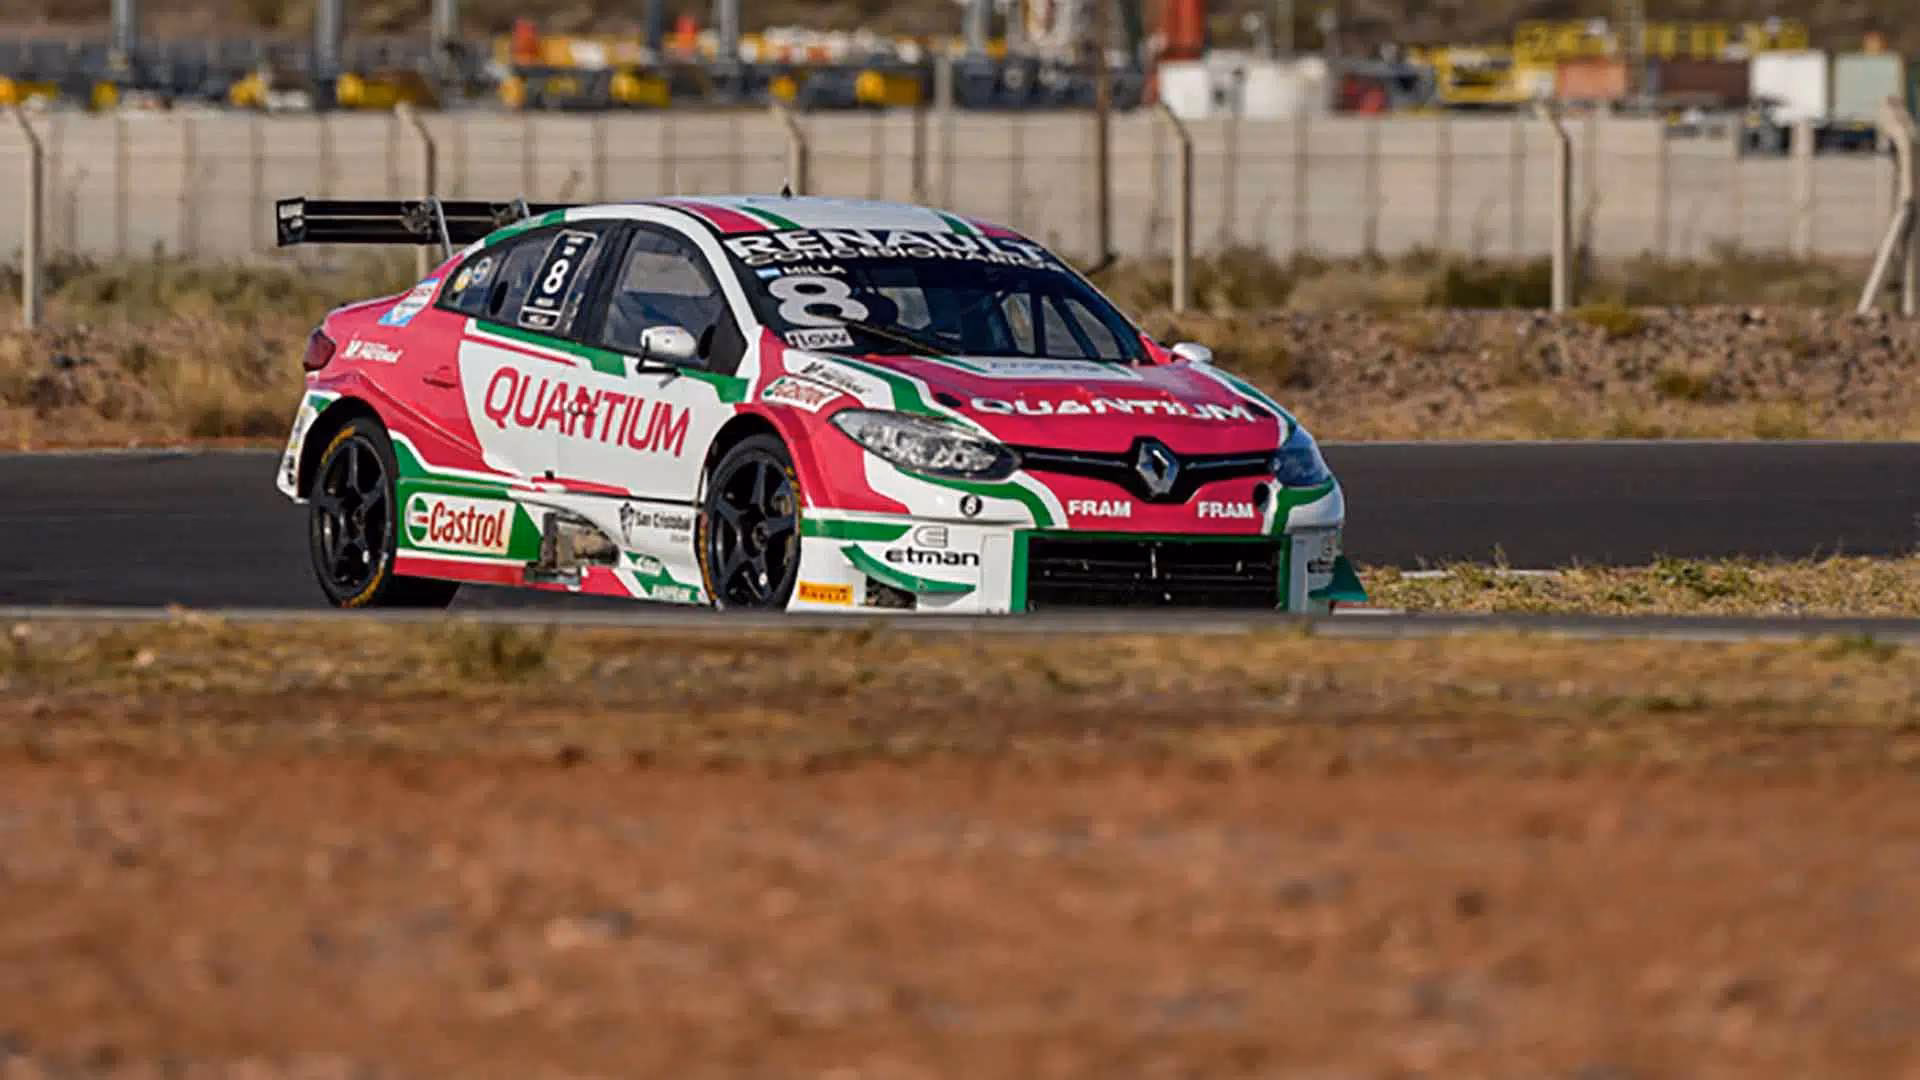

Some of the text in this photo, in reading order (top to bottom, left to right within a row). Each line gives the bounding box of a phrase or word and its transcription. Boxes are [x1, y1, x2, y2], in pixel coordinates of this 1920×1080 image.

[722, 230, 1044, 260] RENAULT
[543, 258, 570, 294] 8
[782, 264, 848, 275] MILLA
[767, 275, 869, 327] 8
[484, 366, 690, 457] QUANTIUM
[970, 396, 1257, 422] QUANTIUM
[1067, 500, 1131, 517] FRAM
[1198, 502, 1255, 518] FRAM
[429, 501, 506, 547] Castrol
